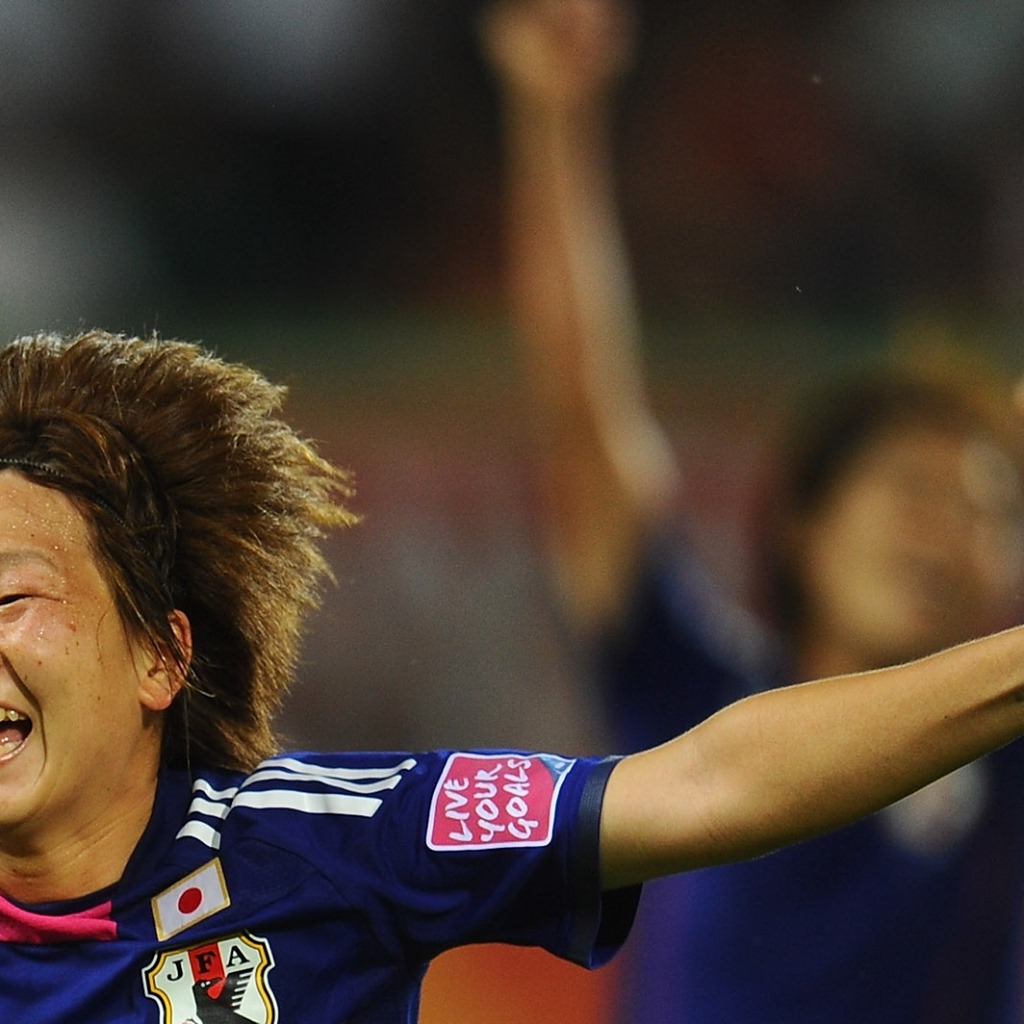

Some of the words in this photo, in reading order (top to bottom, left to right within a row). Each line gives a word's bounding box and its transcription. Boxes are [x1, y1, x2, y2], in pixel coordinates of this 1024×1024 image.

[443, 777, 473, 842] LIVE
[473, 763, 505, 842] YOUR
[503, 759, 539, 839] GOALS
[166, 945, 250, 981] JFA
